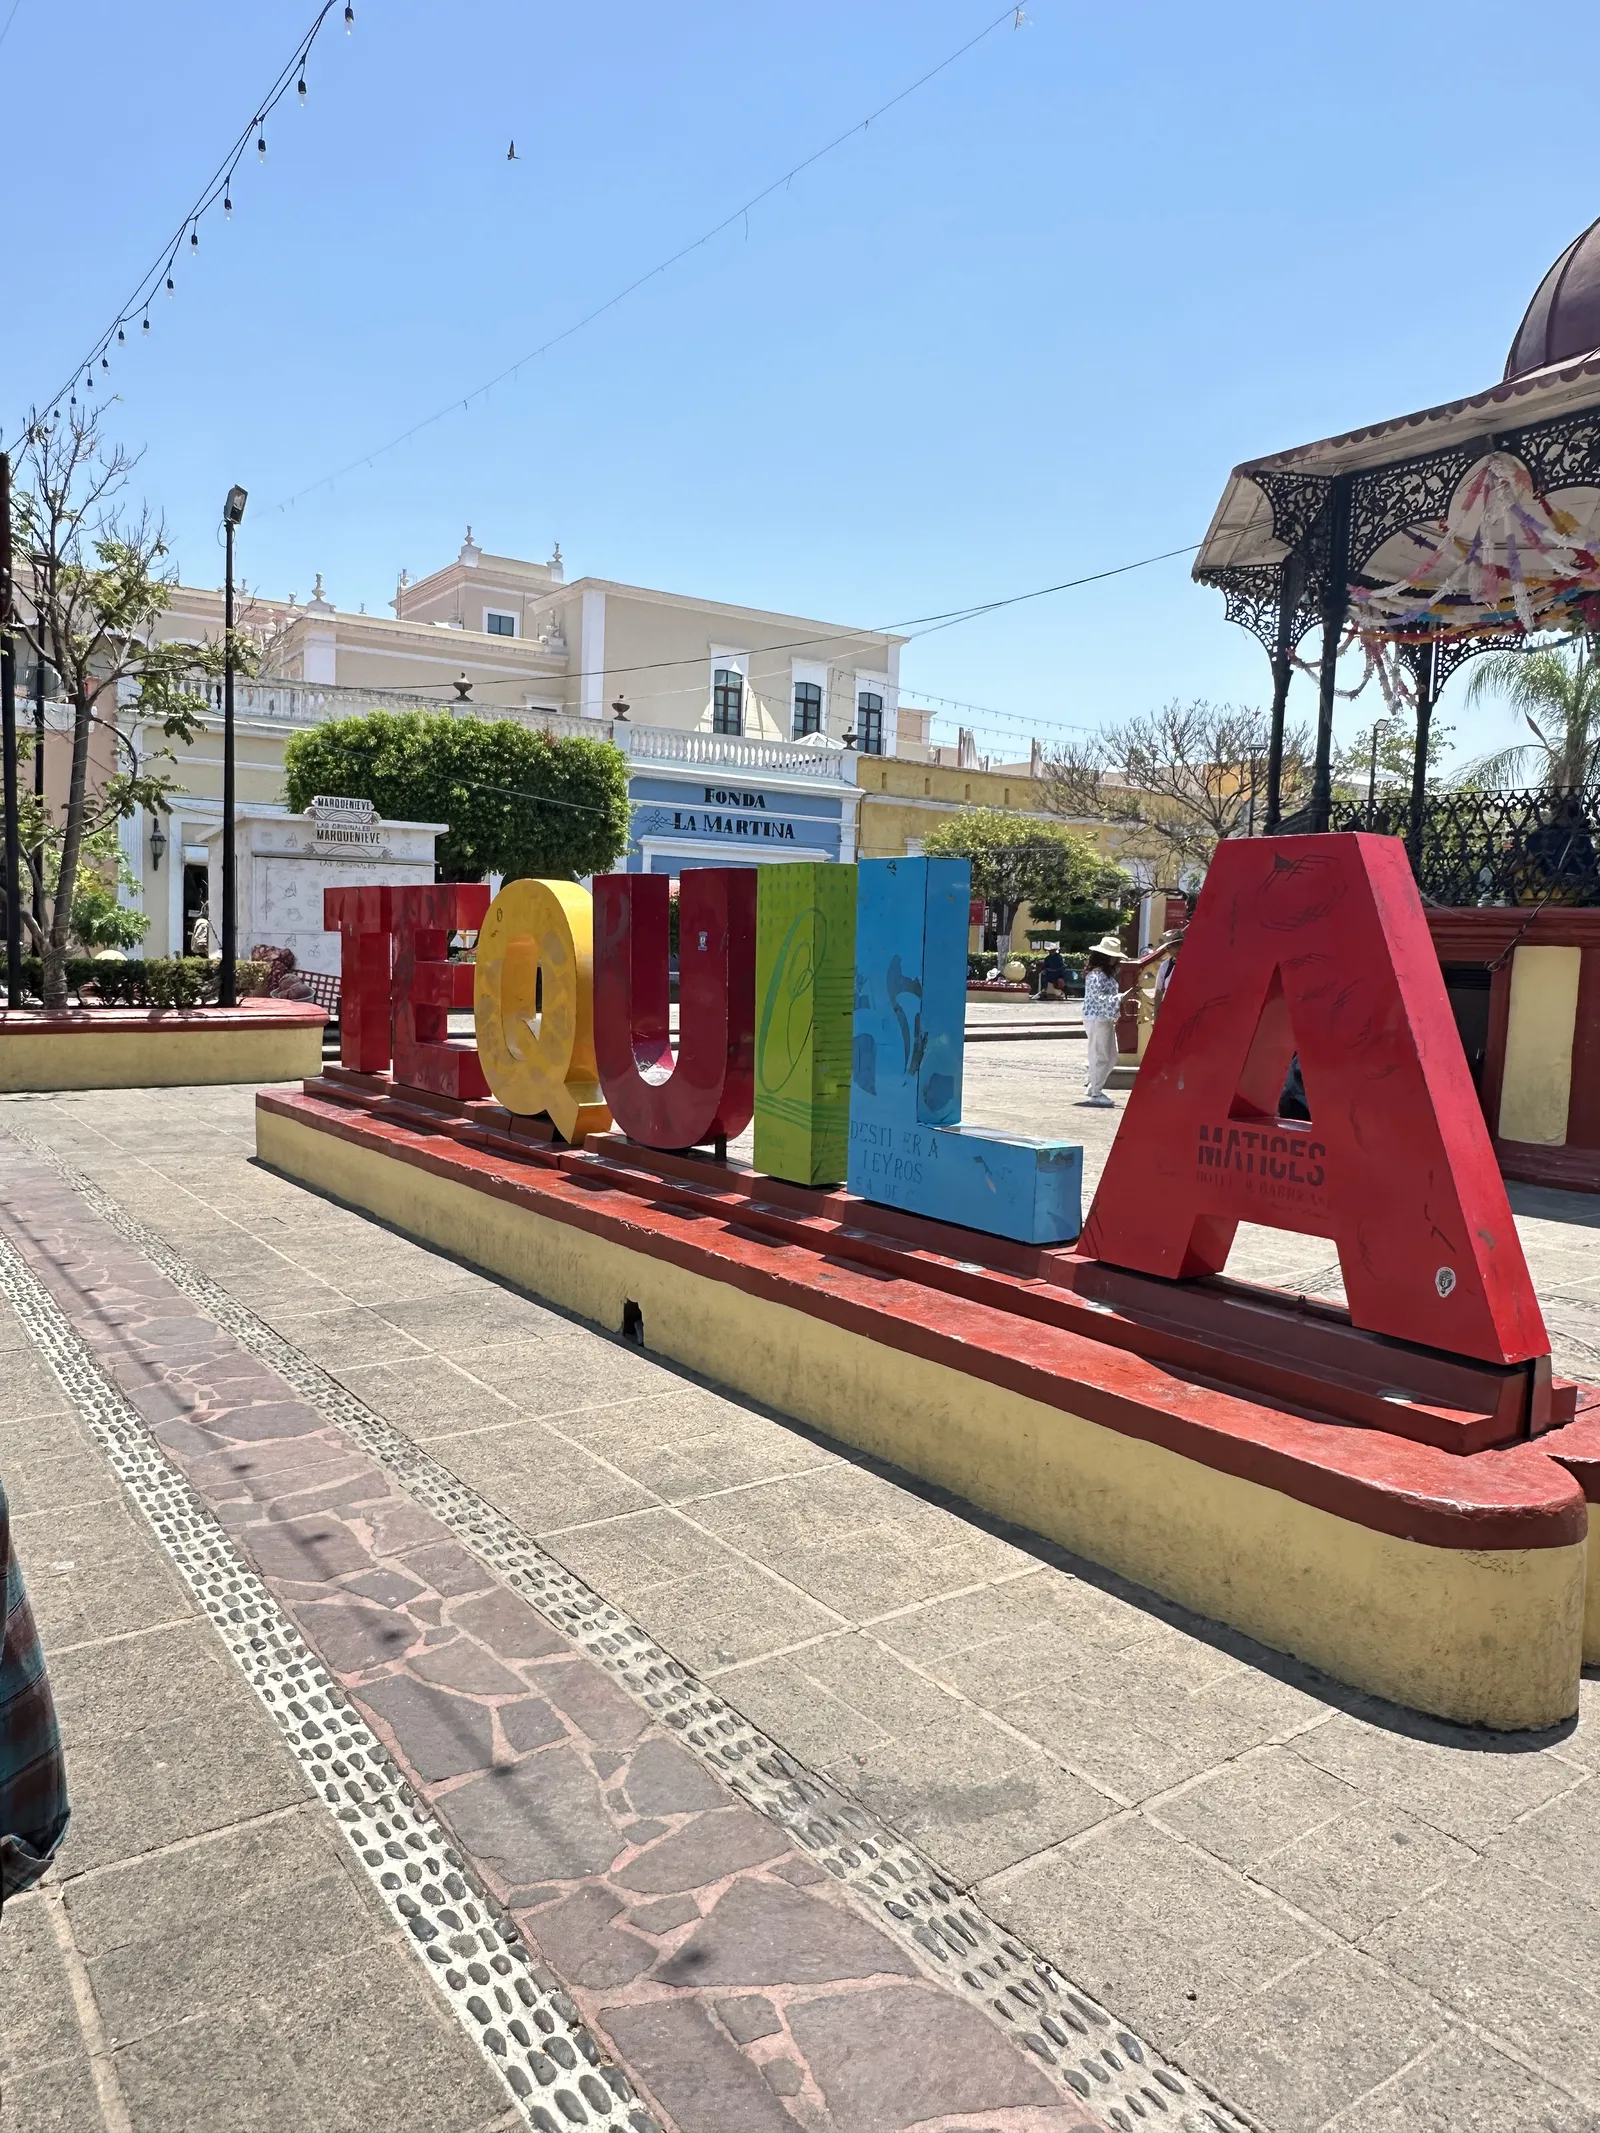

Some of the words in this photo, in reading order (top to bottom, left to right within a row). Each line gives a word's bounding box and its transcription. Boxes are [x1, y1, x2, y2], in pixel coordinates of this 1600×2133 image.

[317, 797, 371, 811] MARQUENIEVE
[704, 788, 766, 808] FONDA
[316, 829, 381, 844] MARQUENIEVE
[674, 812, 696, 831] LA
[703, 814, 795, 839] MARTINA
[323, 832, 1552, 1366] TEQUILA
[1197, 1125, 1326, 1186] MATICES
